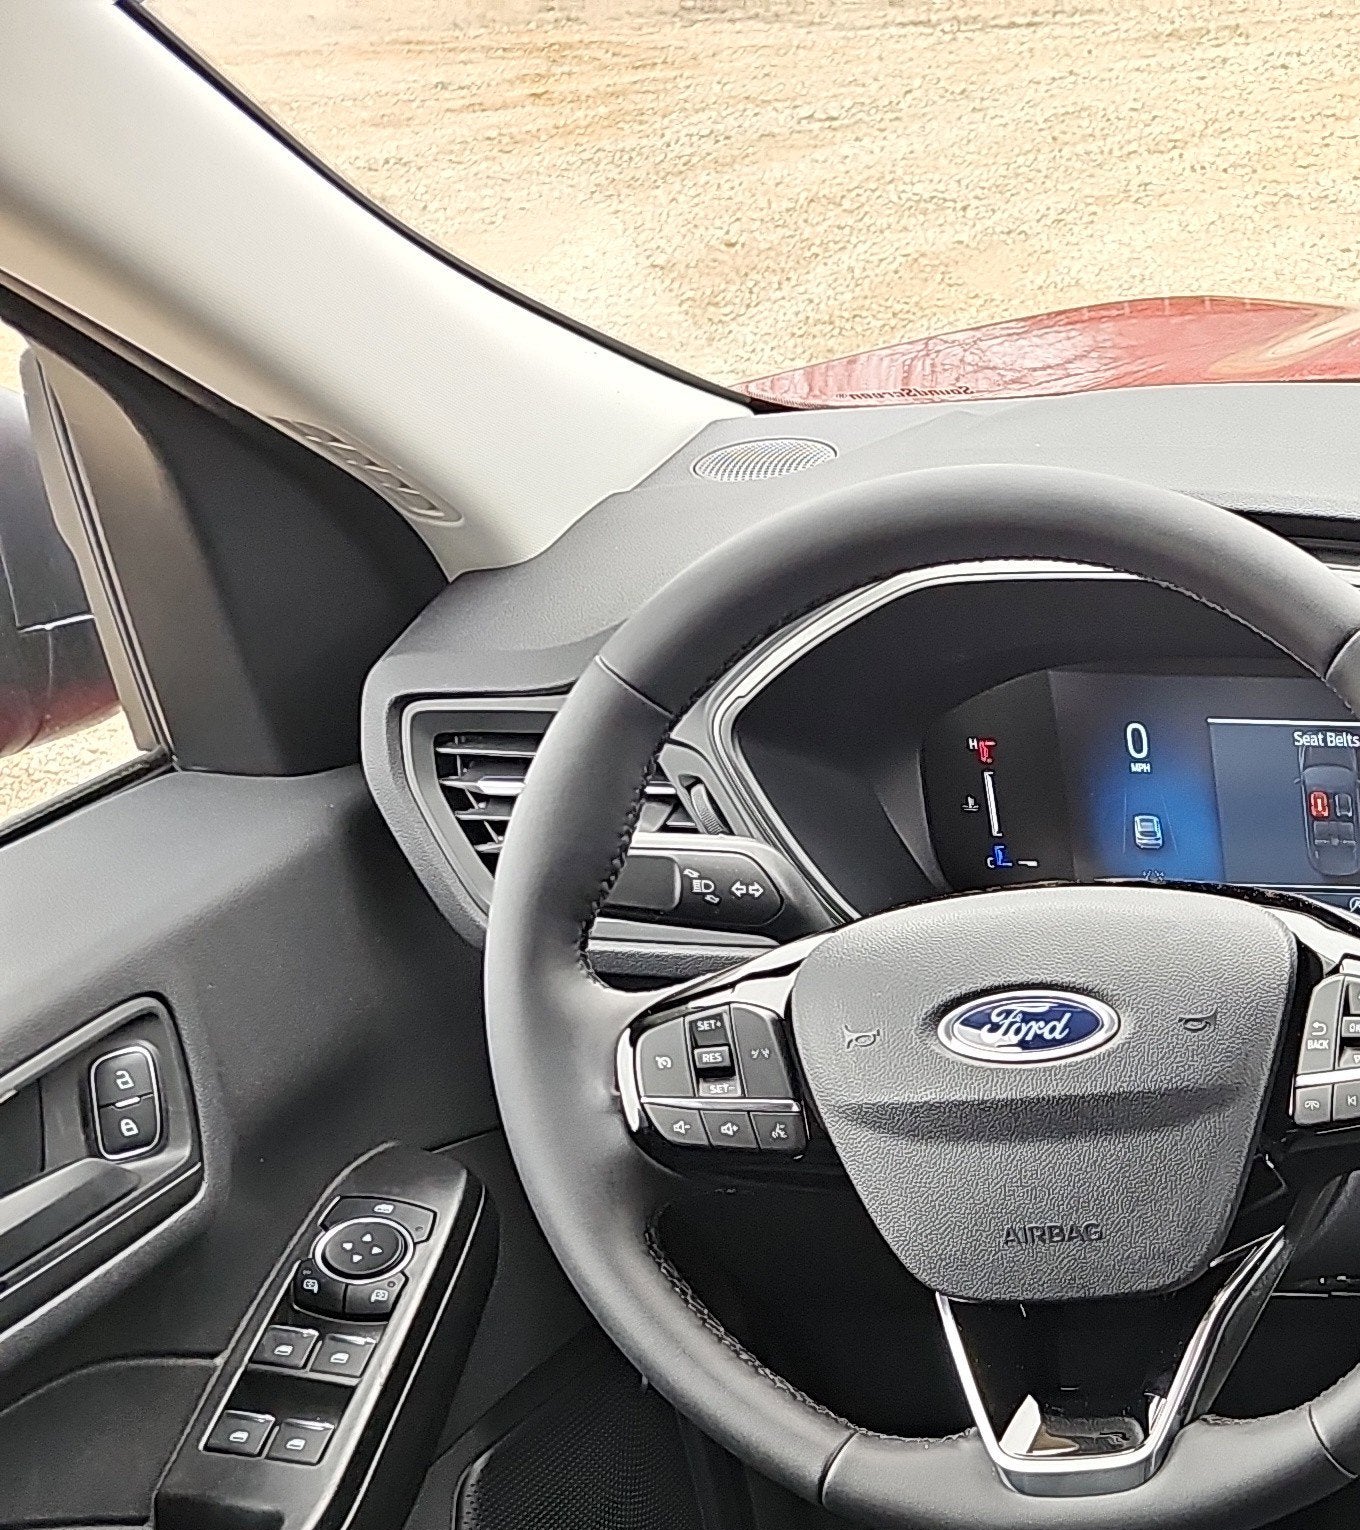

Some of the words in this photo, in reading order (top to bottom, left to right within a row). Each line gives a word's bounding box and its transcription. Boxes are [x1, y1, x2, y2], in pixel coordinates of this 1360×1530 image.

[968, 738, 978, 749] H
[1293, 731, 1324, 747] Seat
[1326, 732, 1360, 748] Belts
[1130, 763, 1151, 773] MPH
[980, 1002, 1072, 1044] Ford
[1307, 1039, 1329, 1050] BACK
[702, 1052, 723, 1063] RES
[1001, 1223, 1105, 1248] AIRBAG
